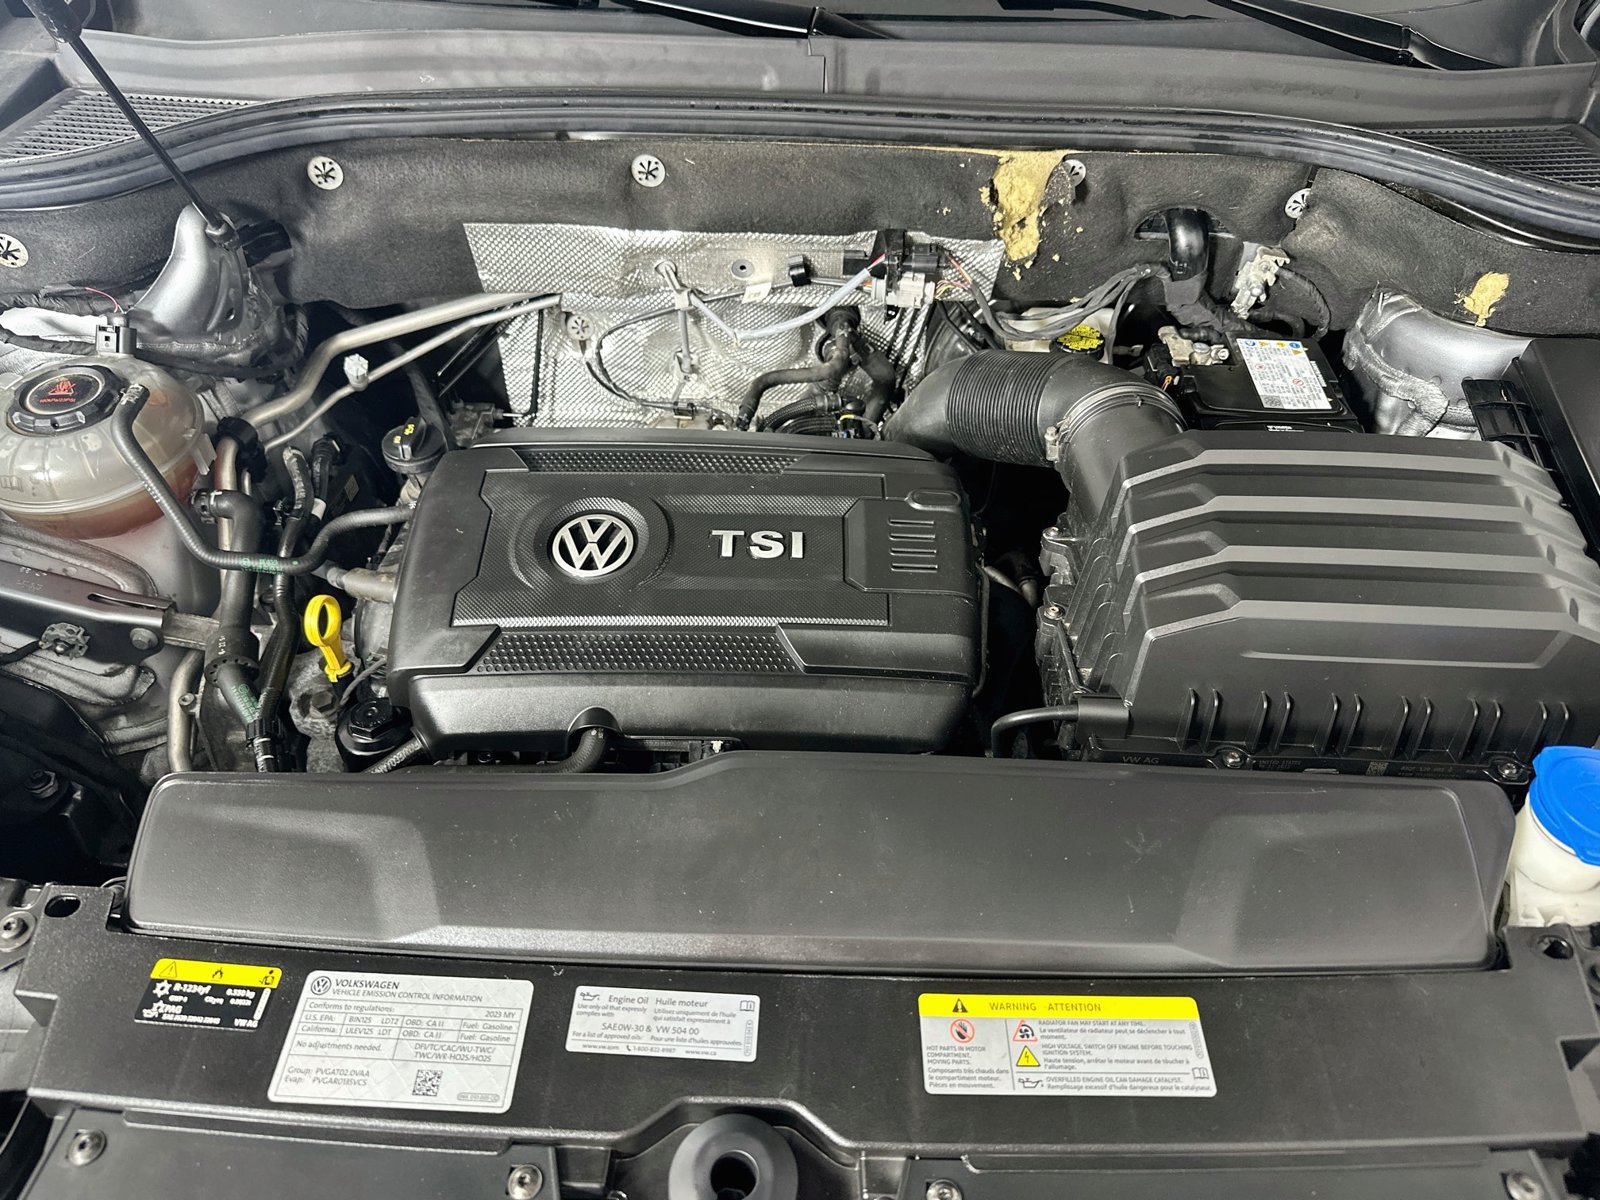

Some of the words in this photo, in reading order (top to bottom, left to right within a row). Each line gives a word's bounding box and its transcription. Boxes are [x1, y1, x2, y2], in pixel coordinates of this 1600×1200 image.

[710, 530, 804, 559] TSI
[1122, 756, 1141, 764] VW
[335, 979, 400, 990] VOLKSWAGEN
[332, 988, 361, 997] VEHICLE
[361, 990, 396, 998] EMISSION
[397, 991, 431, 1000] CONTROL
[432, 993, 483, 1002] INFORMATION
[608, 995, 636, 1005] Engine
[637, 996, 649, 1004] Oil
[308, 1001, 343, 1011] Conforms
[344, 1003, 352, 1011] to
[353, 1003, 395, 1013] regulations:
[655, 998, 677, 1006] Huile
[989, 1002, 1037, 1011] WARNING
[1047, 1003, 1101, 1012] ATTENTION
[305, 1013, 318, 1021] U.S.
[319, 1014, 335, 1022] EPA:
[485, 1010, 502, 1018] 2023
[503, 1011, 516, 1019] MY
[234, 1018, 248, 1027] VW
[248, 1020, 258, 1028] AG
[426, 1019, 437, 1027] CA
[462, 1022, 479, 1030] Fuel:
[482, 1022, 513, 1031] Gasoline
[645, 1024, 652, 1033] &
[655, 1025, 671, 1033] VW
[671, 1026, 687, 1034] 504
[423, 1031, 434, 1039] CA
[460, 1033, 477, 1041] Fuel:
[479, 1034, 511, 1043] Gasoline
[296, 1040, 307, 1048] No
[308, 1041, 353, 1050] adjustments
[354, 1043, 381, 1052] needed.
[287, 1065, 312, 1076] Group:
[927, 1067, 962, 1075] Composants
[935, 1075, 977, 1083] compartiment
